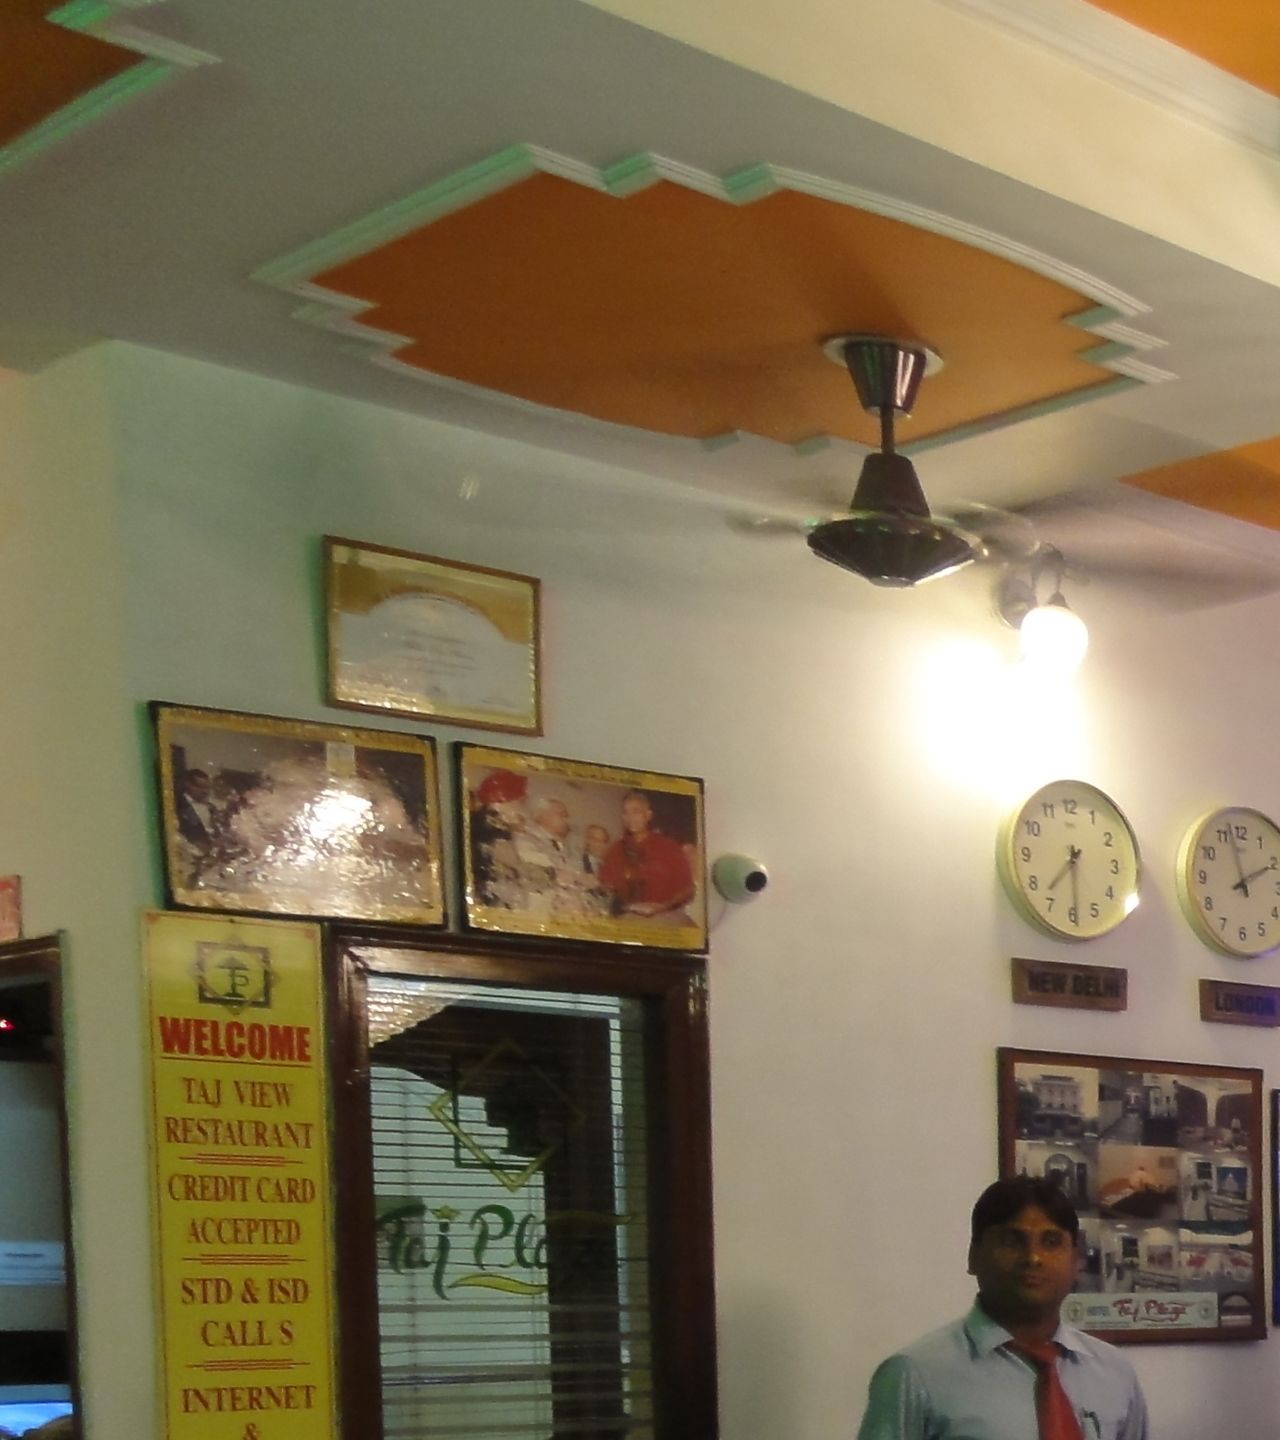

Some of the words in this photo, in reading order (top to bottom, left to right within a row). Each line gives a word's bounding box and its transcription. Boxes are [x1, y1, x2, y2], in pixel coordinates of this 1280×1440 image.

[1042, 802, 1056, 819] 11
[1062, 799, 1078, 814] 12
[1089, 810, 1096, 825] 1
[1024, 819, 1041, 837] 10
[1234, 826, 1247, 841] 12
[1104, 832, 1113, 847] 2
[1216, 829, 1228, 844] 11
[1257, 836, 1263, 849] 1
[1021, 846, 1031, 862] 9
[1202, 846, 1216, 861] 10
[1110, 859, 1119, 875] 3
[1270, 856, 1278, 870] 2
[1028, 875, 1038, 891] 8
[1198, 870, 1207, 884] 9
[1105, 885, 1114, 900] 4
[1045, 897, 1056, 912] 7
[1090, 903, 1099, 918] 5
[1204, 896, 1213, 911] 8
[1068, 907, 1078, 924] 6
[1271, 906, 1278, 920] 4
[1219, 917, 1227, 930] 7
[1257, 922, 1265, 936] 5
[1238, 926, 1246, 941] 6
[159, 1016, 312, 1062] WELCOME
[183, 1076, 222, 1108] TAJ
[233, 1080, 292, 1108] VIEW
[165, 1116, 314, 1149] RESTAURANT
[168, 1174, 251, 1202] CREDIT
[256, 1176, 316, 1204] CARD
[187, 1217, 301, 1245] ACCEPTED
[181, 1278, 233, 1305] STD
[240, 1278, 260, 1304] &
[268, 1278, 310, 1304] ISD
[181, 1384, 317, 1413] INTERNET
